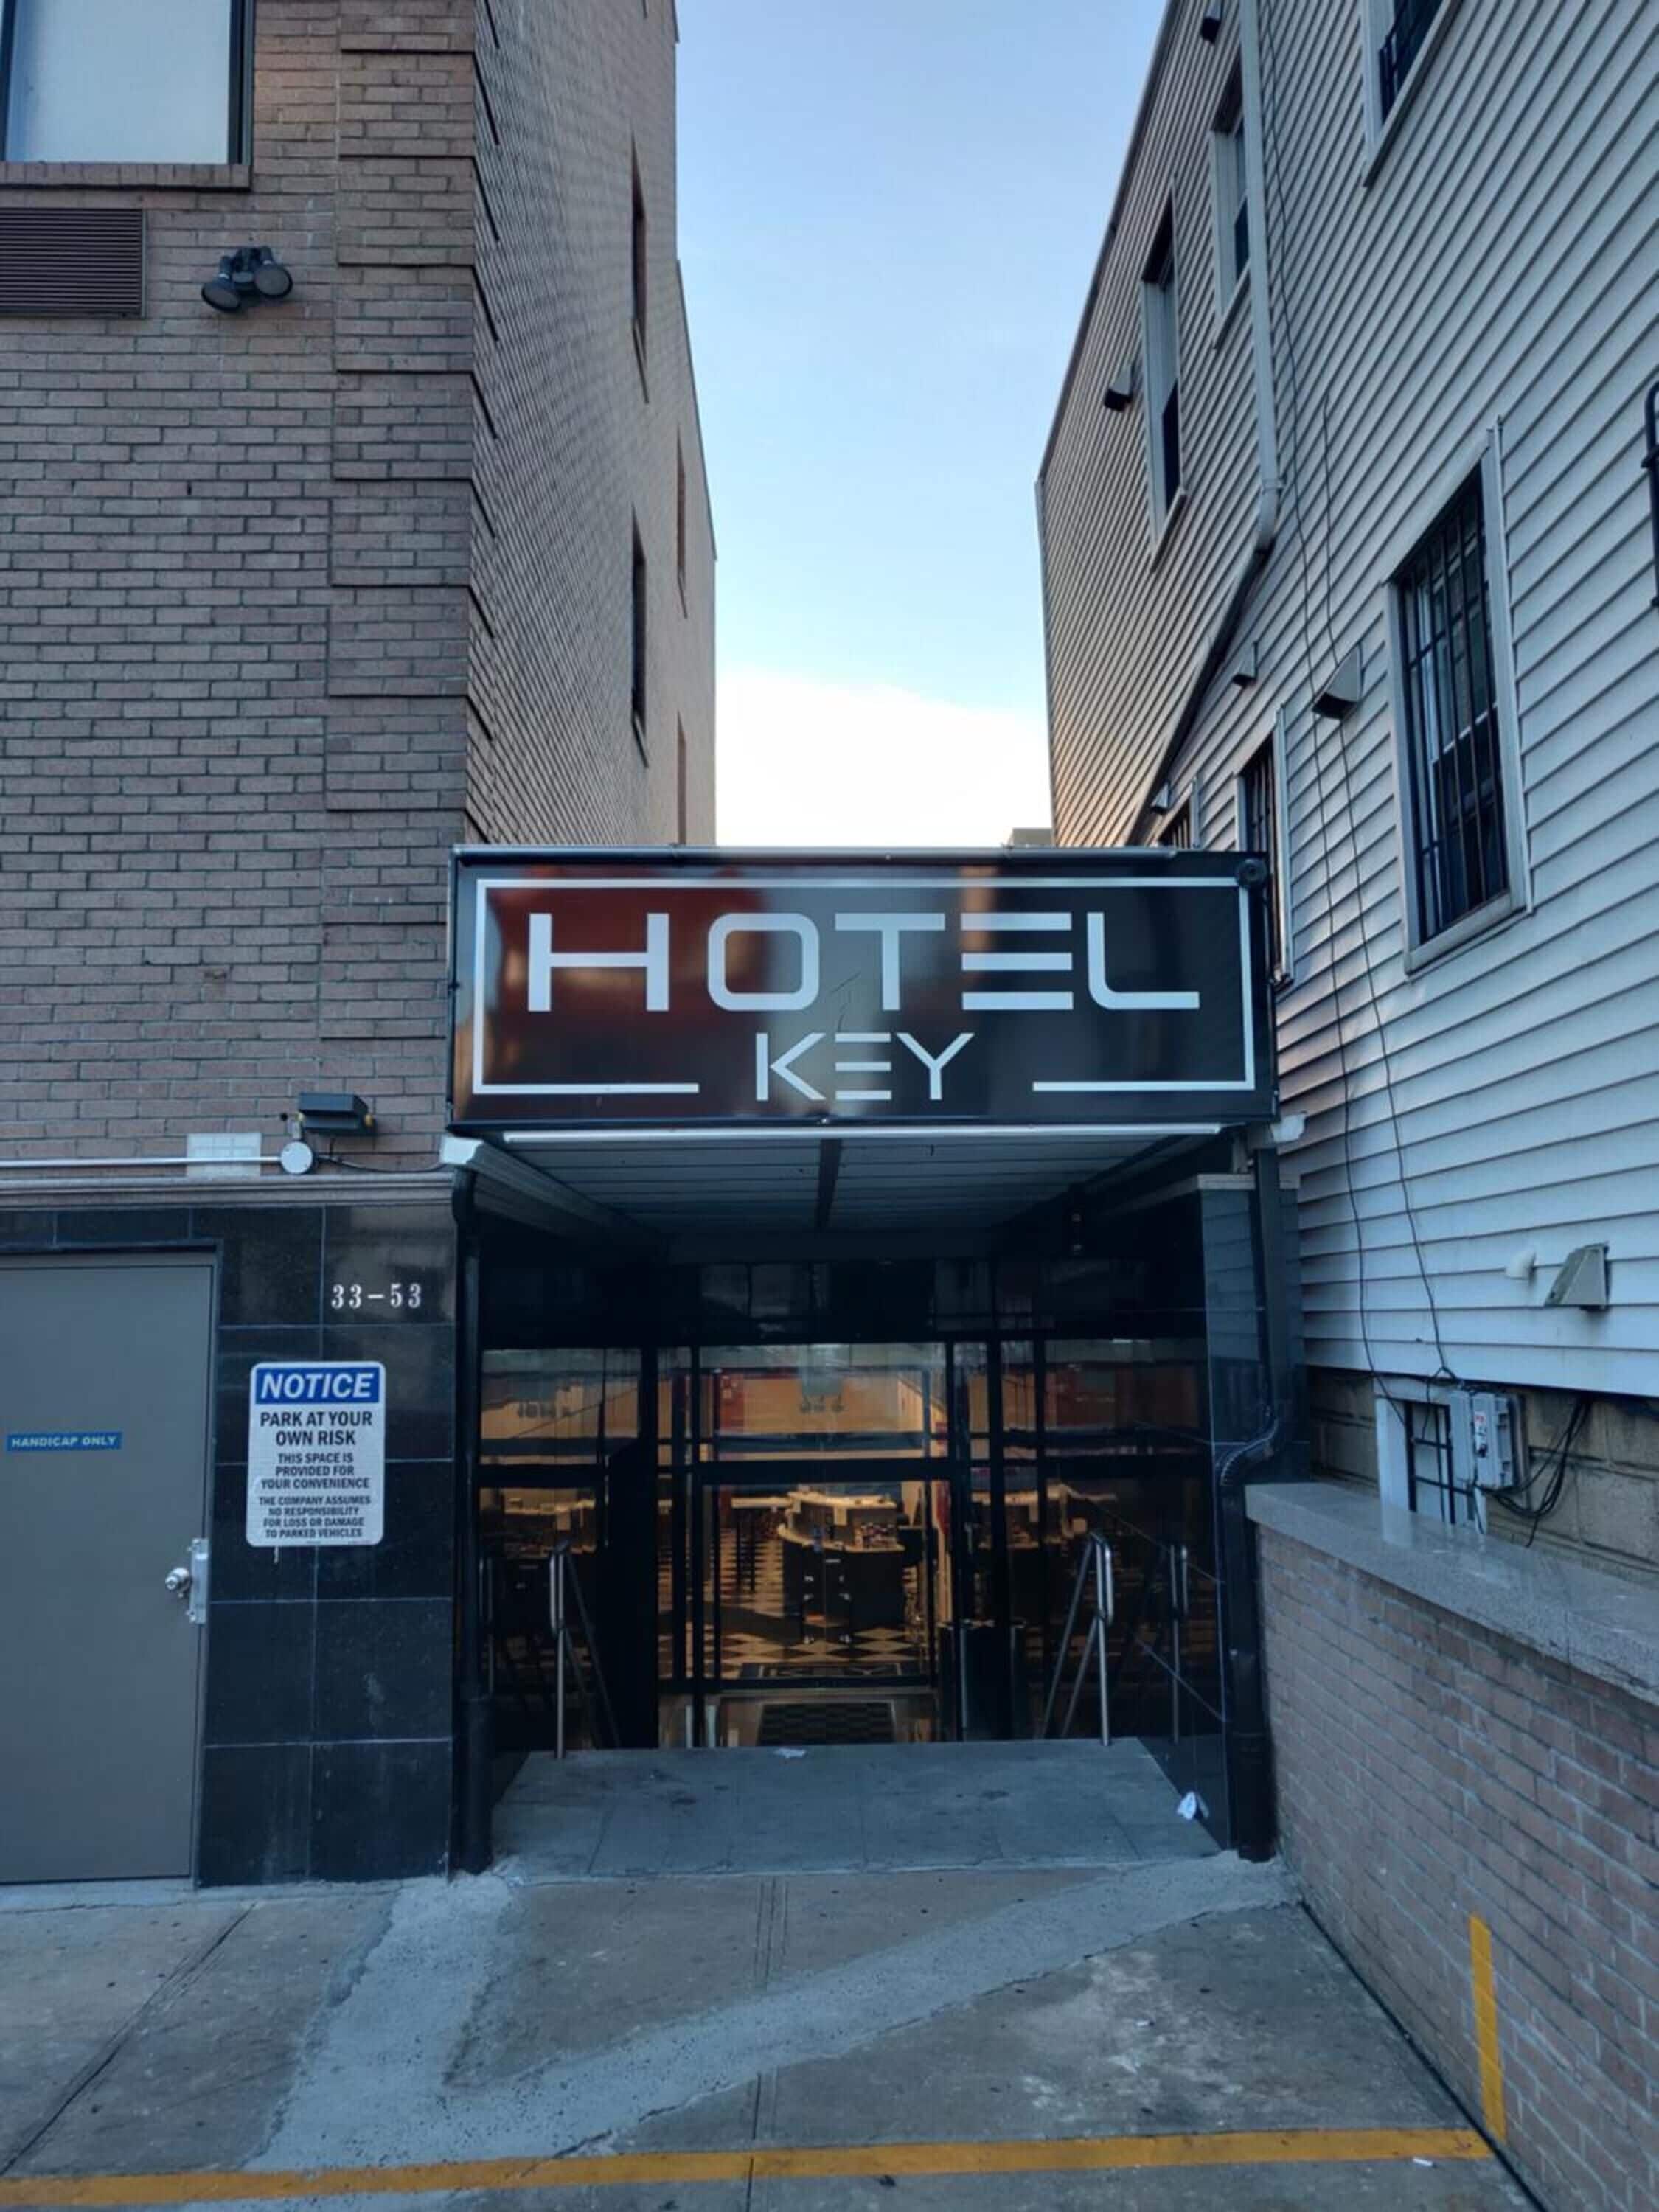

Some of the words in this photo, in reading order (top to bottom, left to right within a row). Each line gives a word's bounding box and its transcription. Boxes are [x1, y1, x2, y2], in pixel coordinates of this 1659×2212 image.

[527, 911, 1200, 1012] HOTEL
[755, 1032, 975, 1102] KEY
[331, 1282, 422, 1310] 33-53
[261, 1373, 373, 1399] NOTICE
[260, 1412, 302, 1427] PARK
[306, 1412, 325, 1426] AT
[329, 1411, 372, 1426] YOUR
[12, 1438, 77, 1447] HANDICAP
[82, 1437, 116, 1446] ONLY
[276, 1431, 313, 1445] OWN
[318, 1430, 356, 1445] RISK
[278, 1453, 302, 1463] THIS
[305, 1453, 339, 1463] SPACE
[343, 1453, 353, 1462] IS
[276, 1466, 330, 1476] PROVIDED
[333, 1466, 355, 1475] FOR
[261, 1479, 291, 1489] YOUR
[295, 1478, 370, 1489] CONVENIENCE
[260, 1497, 276, 1505] THE
[278, 1496, 324, 1505] COMPANY
[326, 1496, 370, 1504] ASSUMES
[268, 1508, 282, 1516] NO
[285, 1507, 358, 1516] RESPONSIBILITY
[264, 1519, 281, 1527] FOR
[284, 1518, 307, 1526] LOSS
[310, 1518, 322, 1526] OR
[324, 1517, 364, 1526] DAMAGE
[266, 1529, 278, 1537] TO
[279, 1529, 316, 1537] PARKED
[318, 1528, 362, 1537] VEHICLES
